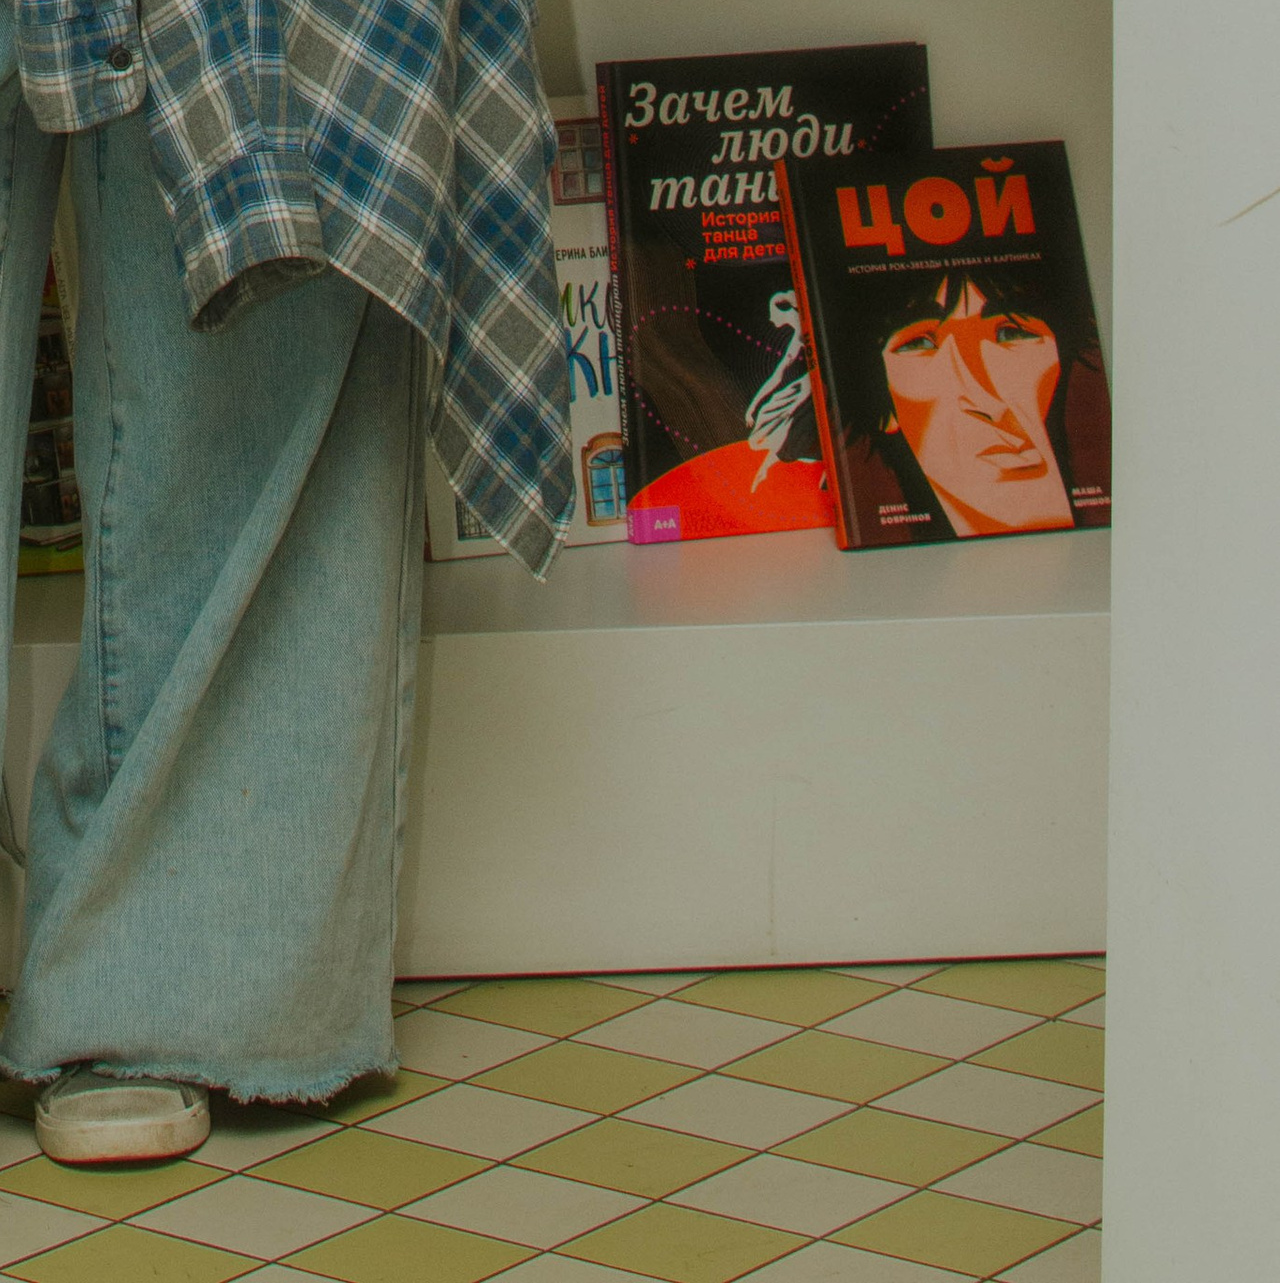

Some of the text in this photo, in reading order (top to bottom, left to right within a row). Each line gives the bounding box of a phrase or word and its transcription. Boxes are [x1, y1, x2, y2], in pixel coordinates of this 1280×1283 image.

[624, 82, 794, 128] Зачем
[711, 113, 855, 165] люди
[598, 84, 618, 271] История танца для детей
[701, 210, 781, 228] История
[835, 156, 1037, 256] ЦОЙ
[702, 228, 759, 245] танца
[703, 244, 739, 263] для
[848, 264, 888, 275] ИСТОРИЯ
[889, 261, 943, 271] РОК-ЗВЕЗДЫ
[952, 256, 982, 267] БУКВАХ
[993, 252, 1042, 263] КАРТИНКАХ
[611, 273, 625, 352] танцуют
